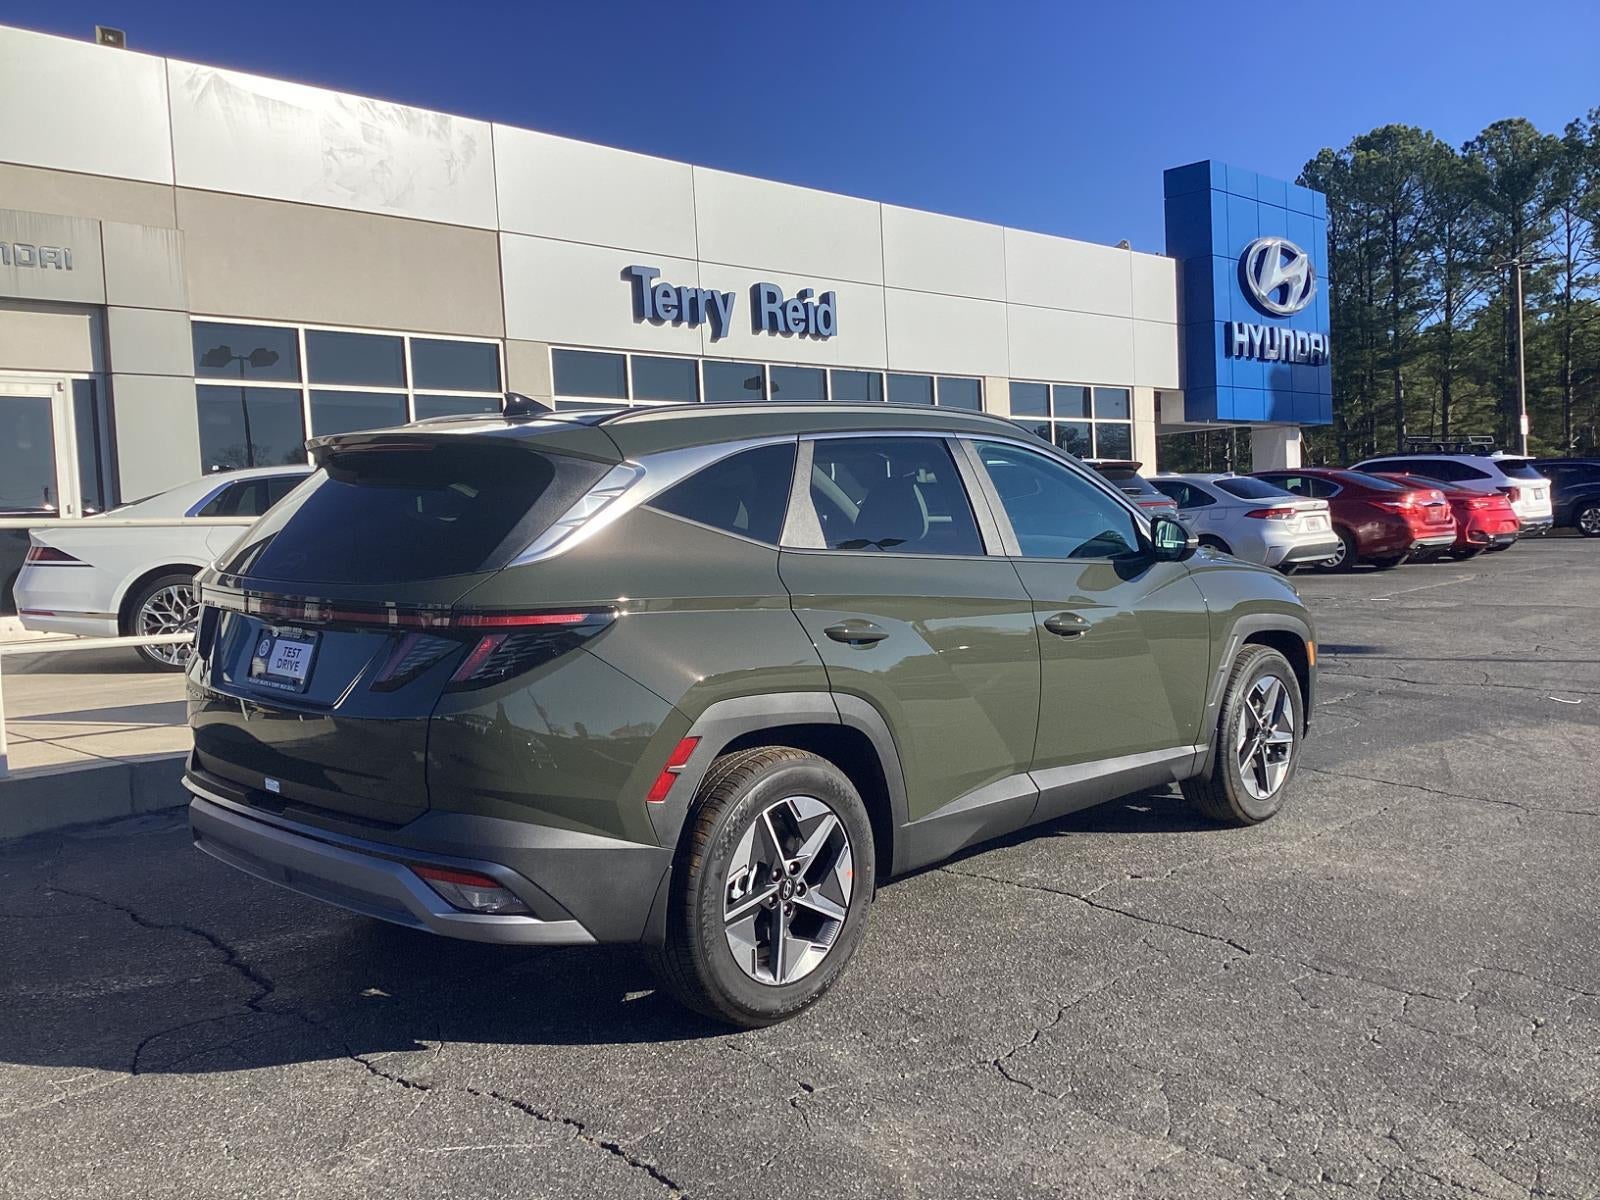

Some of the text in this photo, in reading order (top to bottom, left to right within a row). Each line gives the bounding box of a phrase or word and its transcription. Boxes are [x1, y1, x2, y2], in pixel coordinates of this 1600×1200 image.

[620, 265, 838, 343] Terry Reid
[1224, 321, 1330, 366] HYUNDAI
[276, 658, 300, 672] DRIVE
[283, 646, 302, 658] TEST
